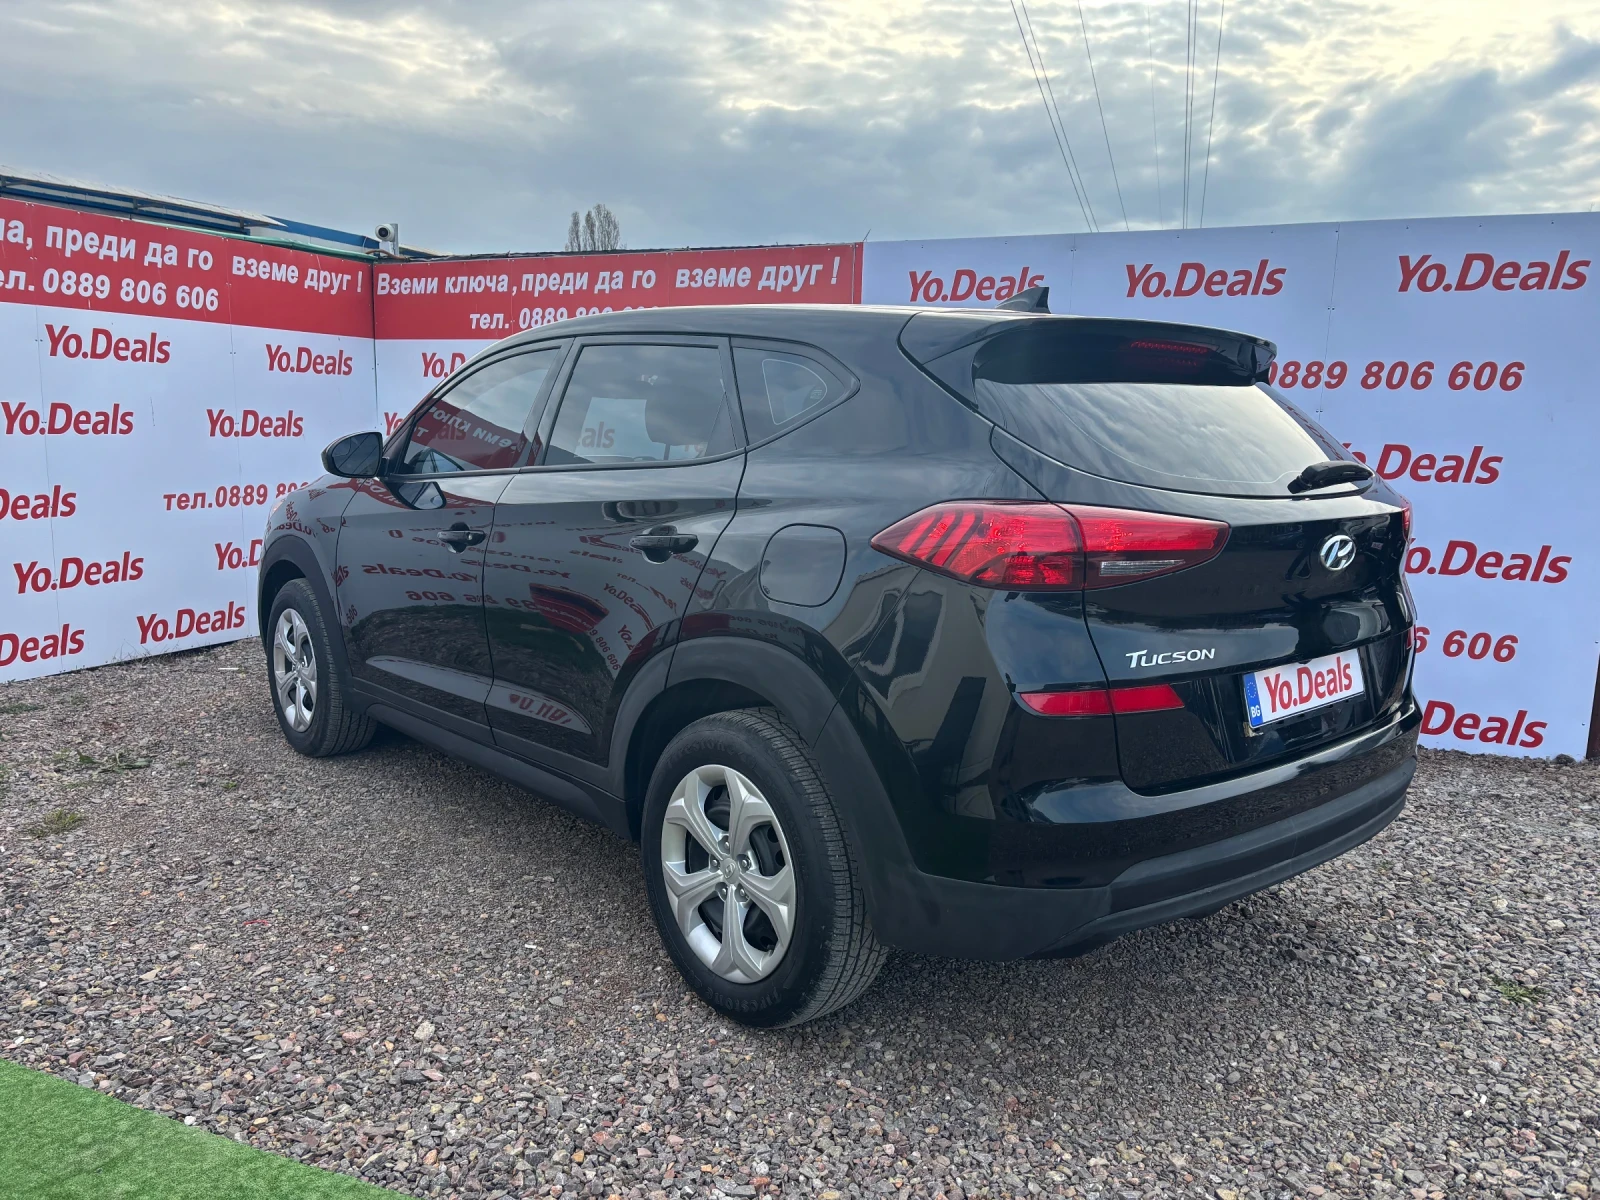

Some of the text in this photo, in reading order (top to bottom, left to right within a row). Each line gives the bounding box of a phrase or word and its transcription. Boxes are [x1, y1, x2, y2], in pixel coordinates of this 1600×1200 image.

[45, 225, 136, 262] преди
[144, 241, 178, 266] да
[187, 248, 213, 271] го
[232, 255, 299, 284] вземе
[304, 268, 351, 295] друг
[356, 270, 363, 293] !
[377, 273, 439, 295] Вземи
[594, 270, 624, 294] да
[631, 269, 656, 289] го
[675, 266, 752, 288] вземе
[757, 264, 824, 292] друг
[830, 256, 841, 285] !
[1126, 259, 1287, 298] Yo.Deals
[1399, 250, 1591, 293] Yo.Deals
[42, 268, 111, 299] 0889
[120, 277, 167, 306] 806
[176, 285, 219, 311] 606
[469, 313, 510, 330] тел.
[45, 324, 171, 364] Yo.Deals
[265, 343, 353, 376] Yo.Deals
[1360, 360, 1436, 391] 806
[1447, 360, 1526, 392] 606
[2, 401, 134, 436] Yo.Deals
[206, 409, 304, 438] Yo.Deals
[13, 551, 144, 595] Yo.Deals
[1404, 538, 1573, 584] o.Deals
[136, 601, 246, 645] Yo.Deals
[1442, 629, 1520, 663] 606
[1263, 656, 1353, 714] Yo.Deals
[1250, 705, 1261, 718] BG
